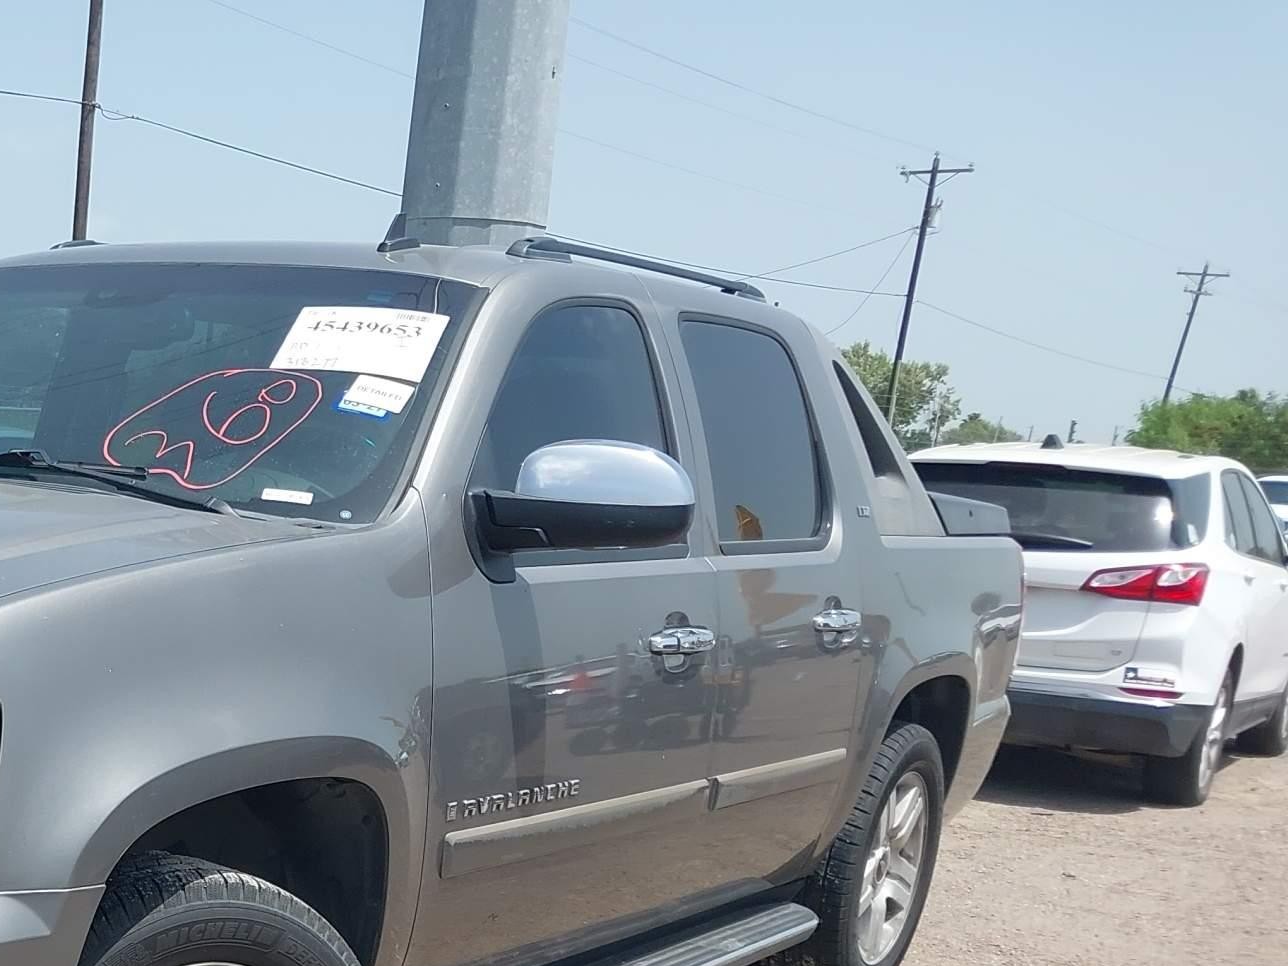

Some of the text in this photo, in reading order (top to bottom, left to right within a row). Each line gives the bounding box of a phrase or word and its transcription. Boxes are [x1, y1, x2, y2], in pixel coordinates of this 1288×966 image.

[307, 320, 423, 338] 45439653
[463, 779, 581, 817] AVALANCHE
[154, 921, 281, 950] MICHELIN
